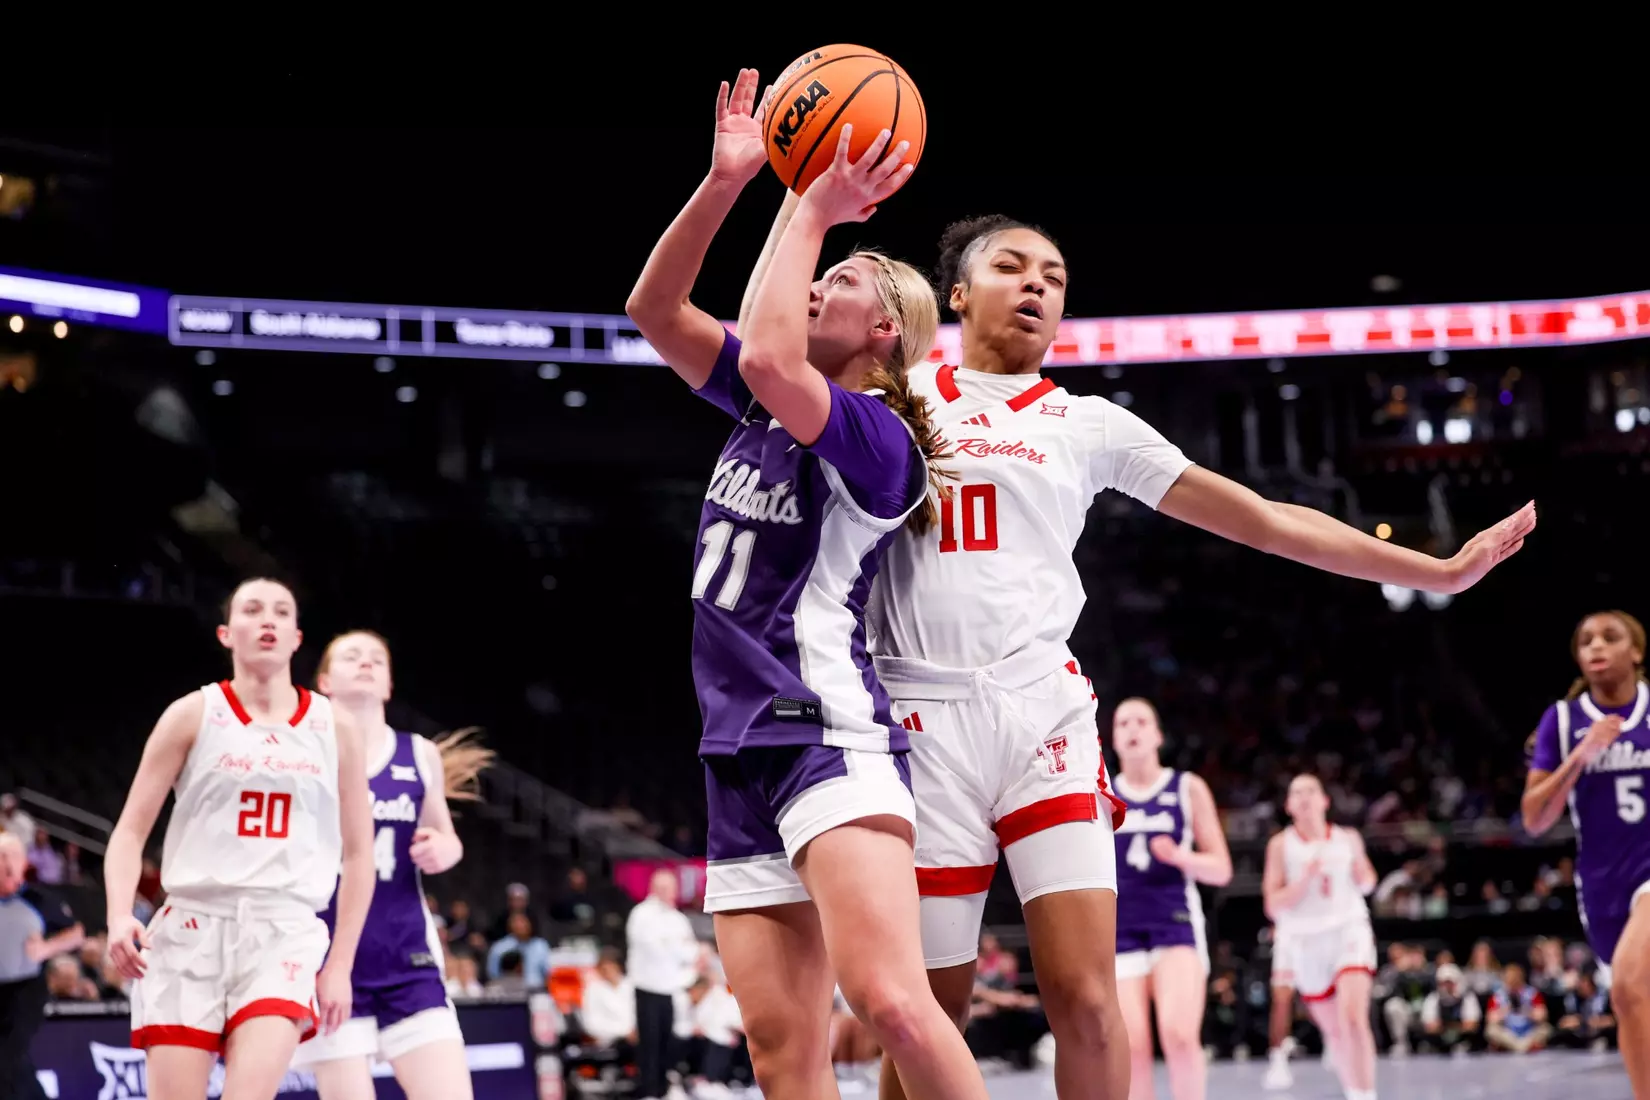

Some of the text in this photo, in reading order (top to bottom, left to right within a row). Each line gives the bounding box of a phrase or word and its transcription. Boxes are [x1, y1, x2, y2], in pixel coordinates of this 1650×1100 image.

[773, 79, 832, 157] NCAA
[956, 438, 1049, 464] Raiders
[705, 458, 803, 525] ildats
[938, 483, 999, 553] 10
[691, 519, 758, 612] 11
[237, 790, 292, 839] 20
[1614, 774, 1647, 825] 5
[1126, 832, 1151, 872] 4
